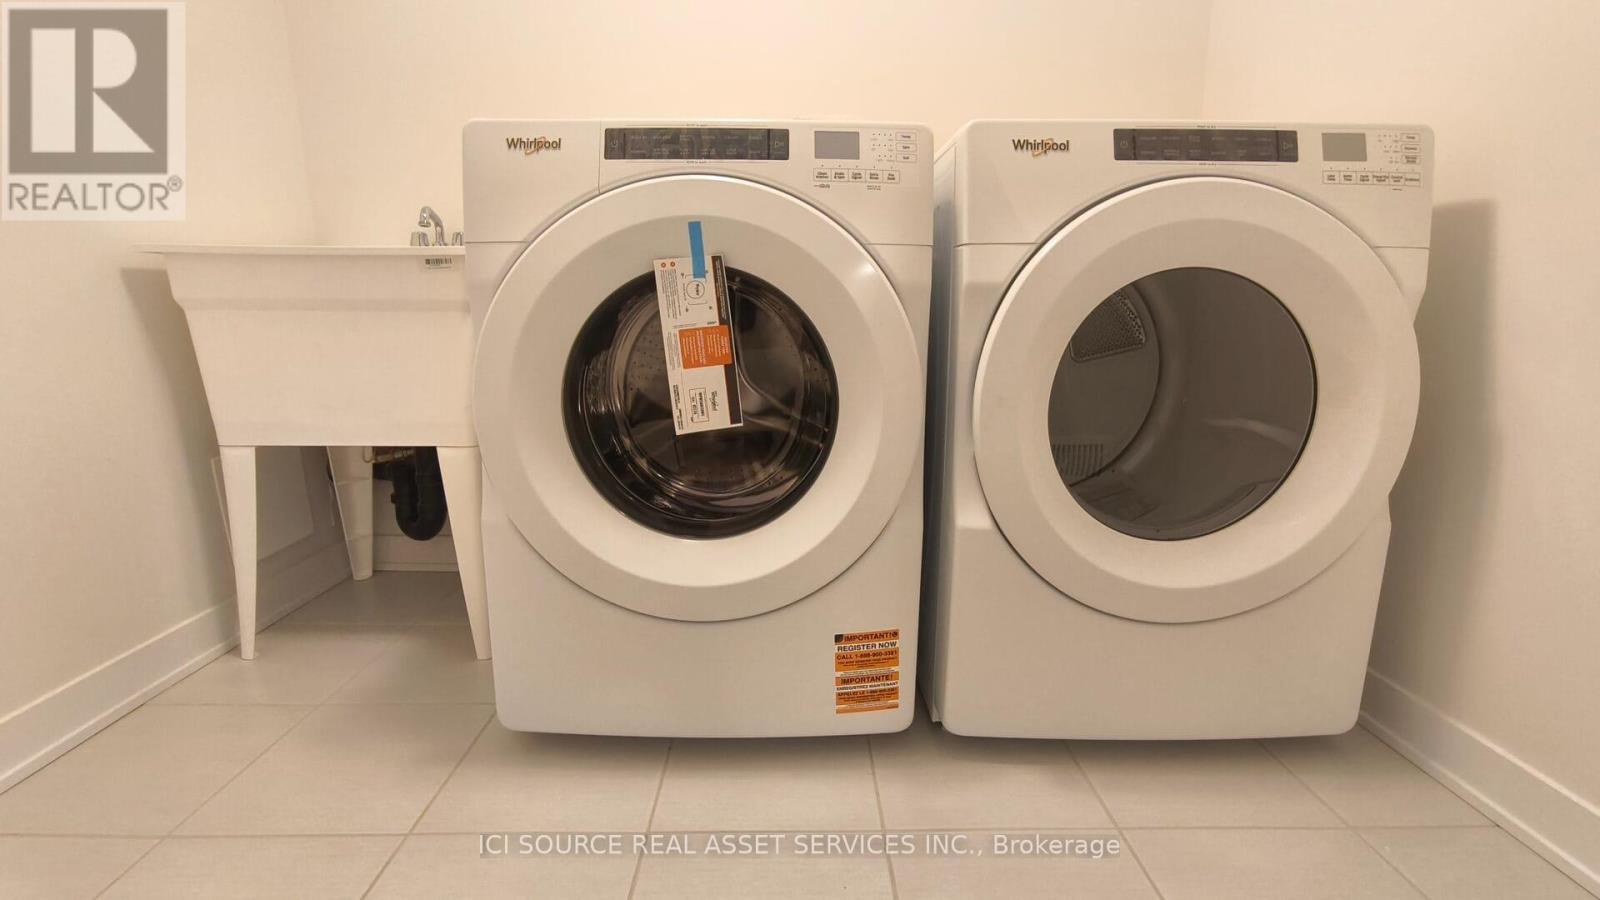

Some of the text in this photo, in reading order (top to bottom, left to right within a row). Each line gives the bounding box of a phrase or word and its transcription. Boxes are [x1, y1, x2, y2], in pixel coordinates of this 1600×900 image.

[506, 137, 561, 153] Whirlpool
[1012, 138, 1069, 154] Whirlpool
[844, 632, 892, 642] IMPORTANT!
[837, 641, 897, 652] REGISTER NOW
